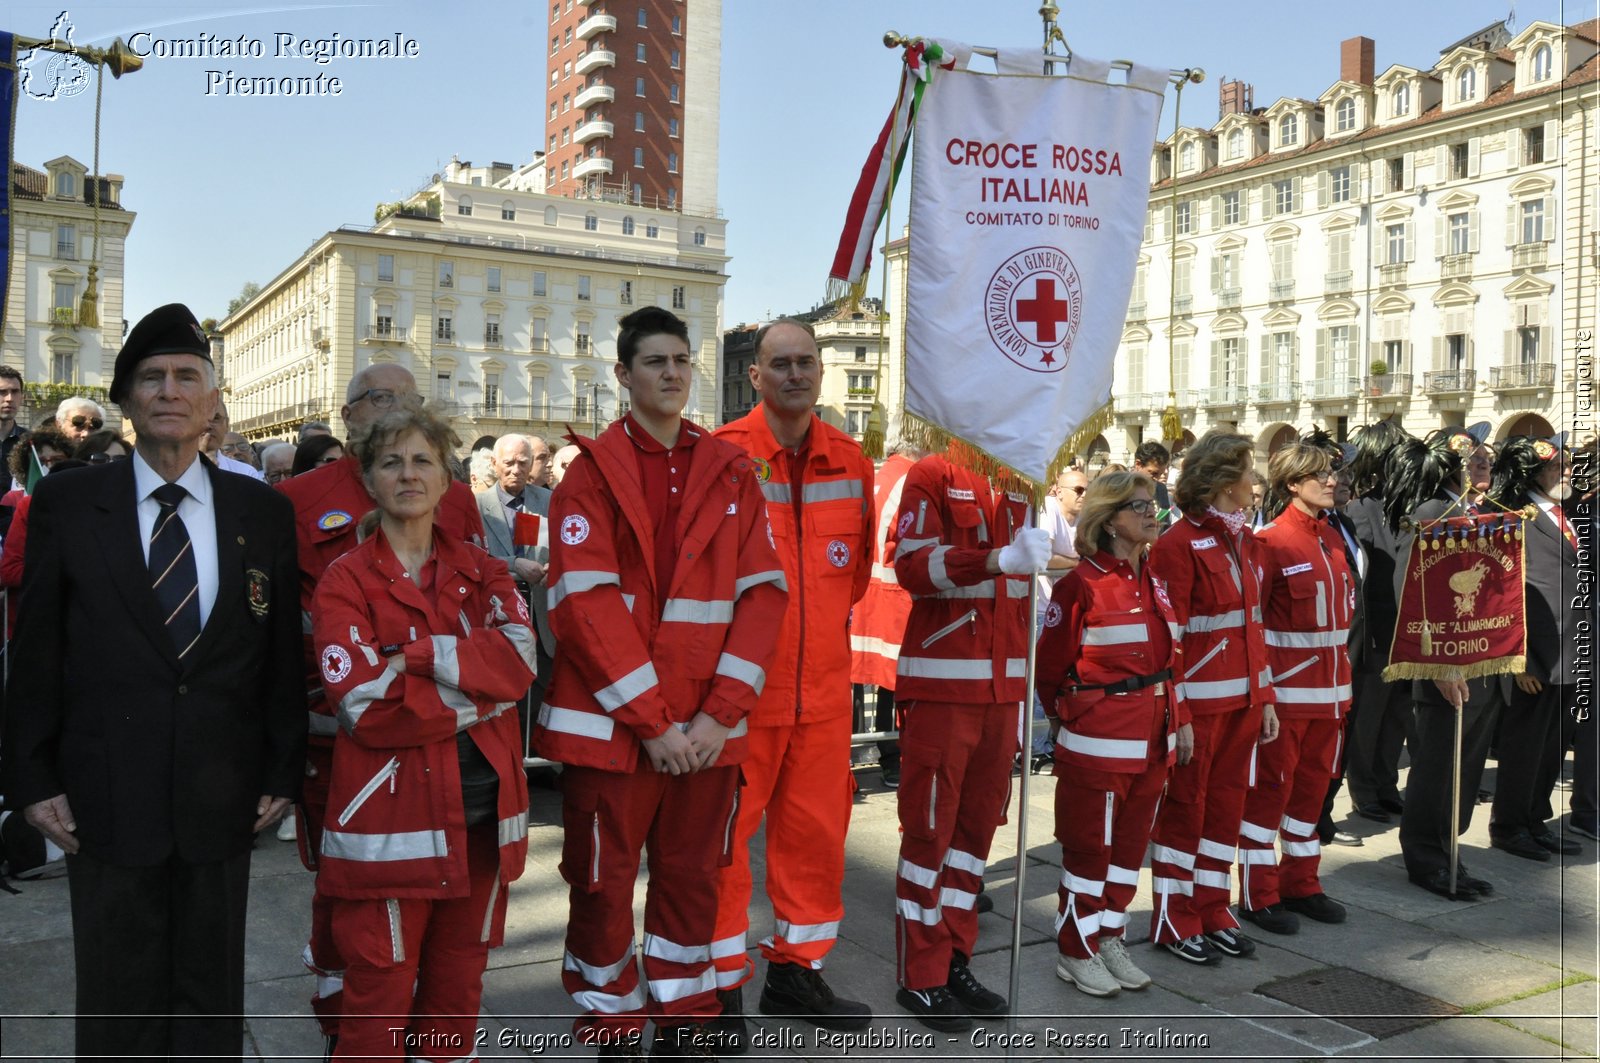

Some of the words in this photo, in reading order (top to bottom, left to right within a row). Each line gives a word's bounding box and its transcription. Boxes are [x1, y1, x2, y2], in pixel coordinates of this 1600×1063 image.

[945, 138, 1037, 169] CROCE
[1052, 144, 1122, 176] ROSSA
[981, 177, 1089, 207] ITALIANA
[966, 211, 1043, 225] COMITATO
[1048, 213, 1060, 226] DI
[1063, 214, 1100, 230] TORINO
[1006, 261, 1024, 280] DI
[1024, 252, 1068, 276] GINEVRA
[990, 275, 1028, 357] CONVENZIONE
[1406, 621, 1447, 634] SEZONE
[1432, 637, 1489, 656] TORINO
